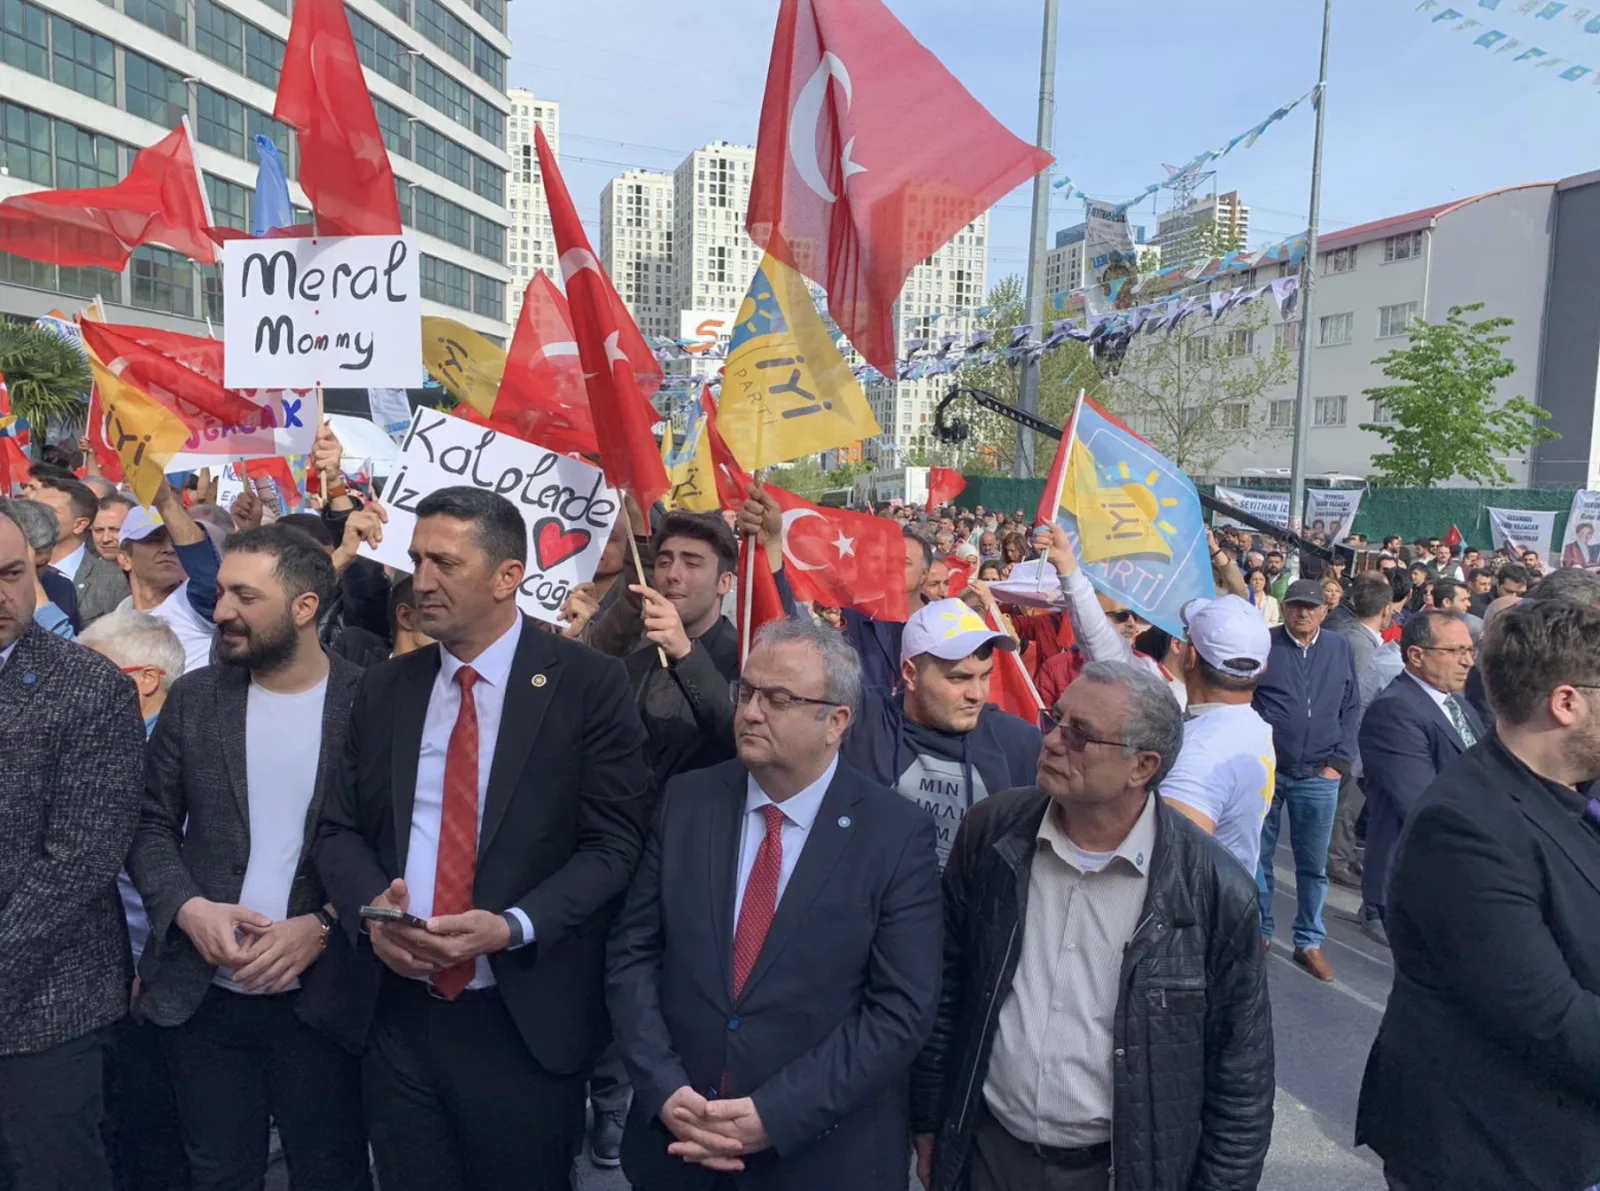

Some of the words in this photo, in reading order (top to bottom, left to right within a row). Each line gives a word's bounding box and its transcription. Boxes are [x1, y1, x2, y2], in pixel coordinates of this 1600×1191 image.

[242, 240, 407, 302] Meral
[255, 315, 374, 370] Mommy
[920, 778, 959, 796] MIN
